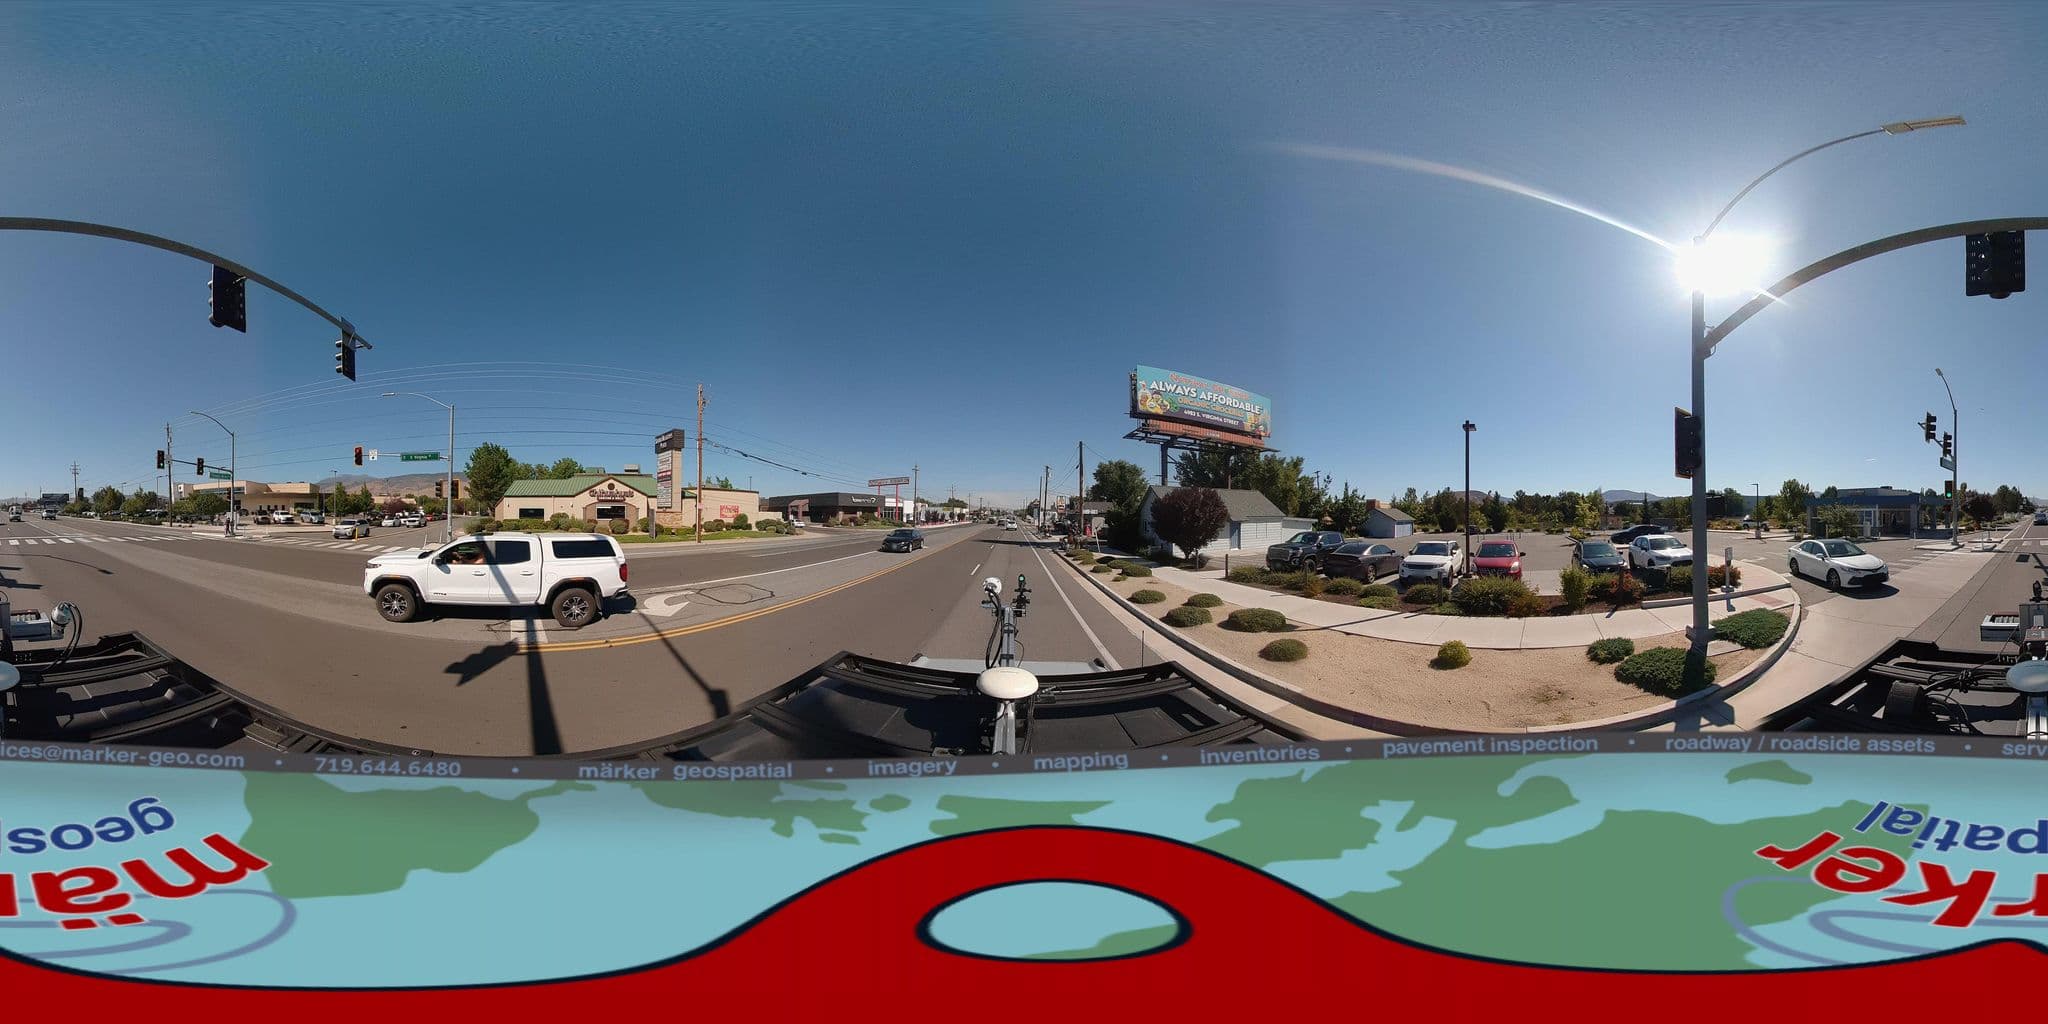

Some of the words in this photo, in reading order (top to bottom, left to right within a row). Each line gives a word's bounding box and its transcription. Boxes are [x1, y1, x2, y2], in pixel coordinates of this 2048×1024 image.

[1150, 380, 1197, 398] ALWAYS
[1199, 392, 1261, 414] AFFORDABLE
[1223, 417, 1239, 426] STREET
